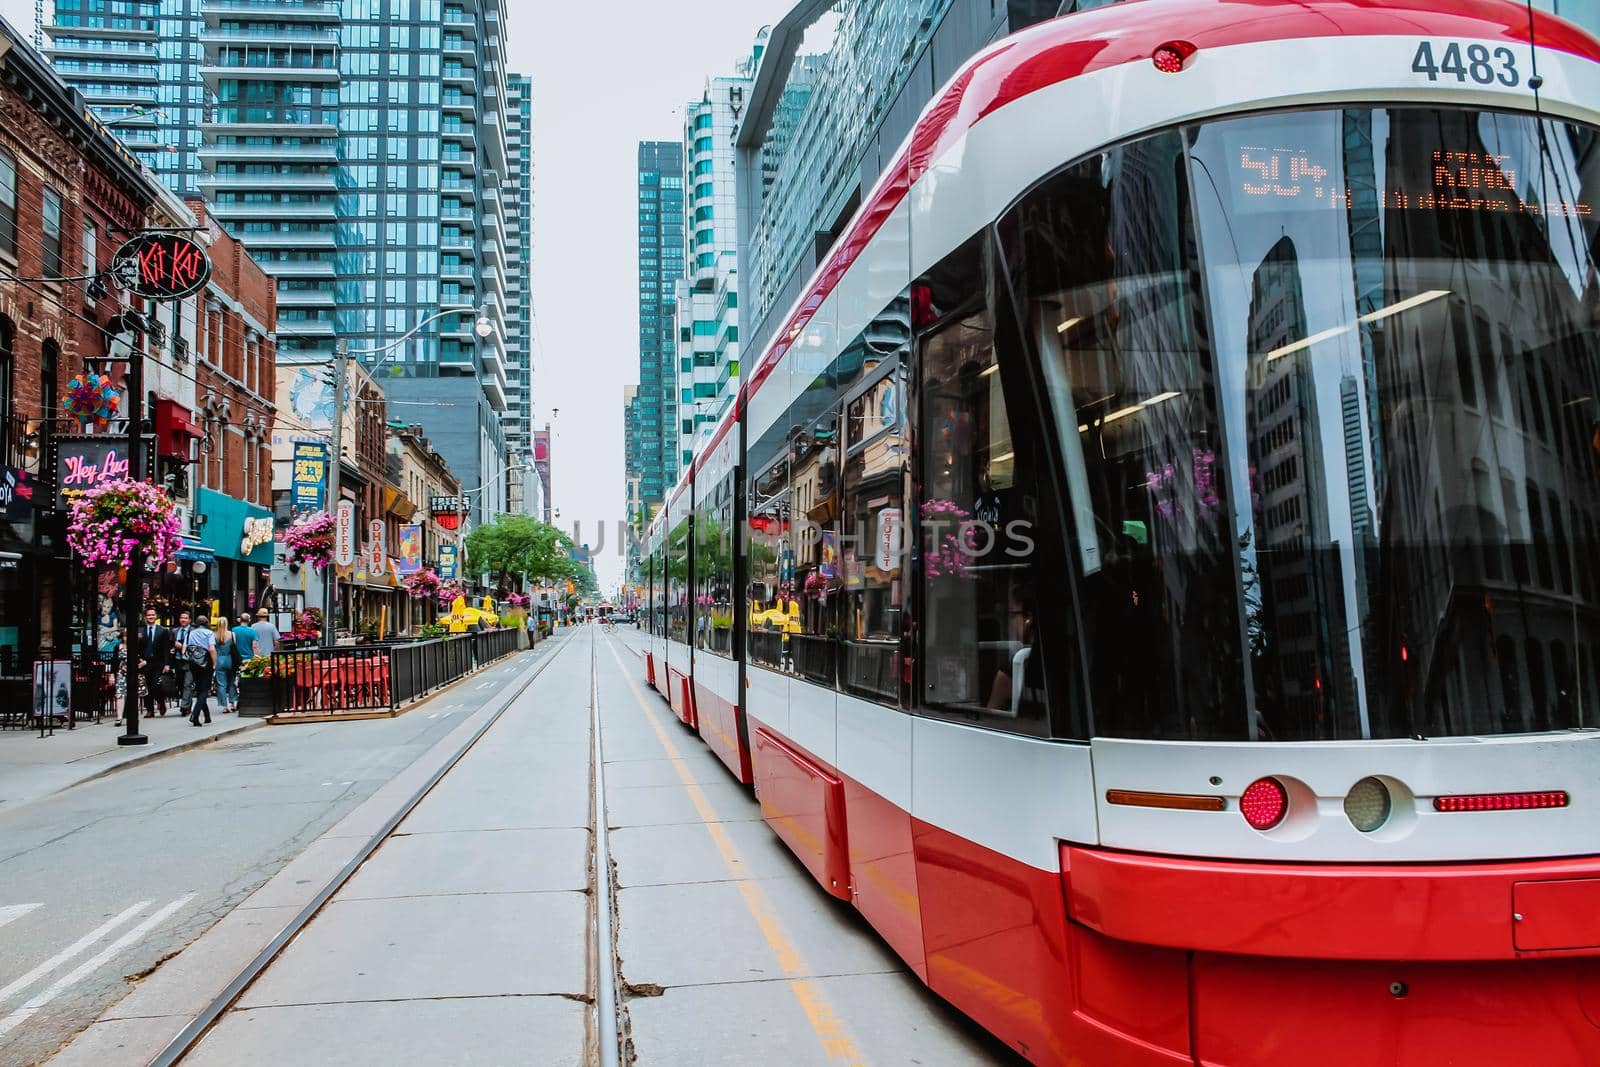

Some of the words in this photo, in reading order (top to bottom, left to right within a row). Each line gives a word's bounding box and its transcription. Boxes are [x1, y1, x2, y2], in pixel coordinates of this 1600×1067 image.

[1411, 41, 1520, 88] 4483
[1240, 146, 1328, 196] 504
[63, 455, 98, 485] Hey
[340, 509, 350, 562] BUFFET
[371, 522, 382, 574] DHABA
